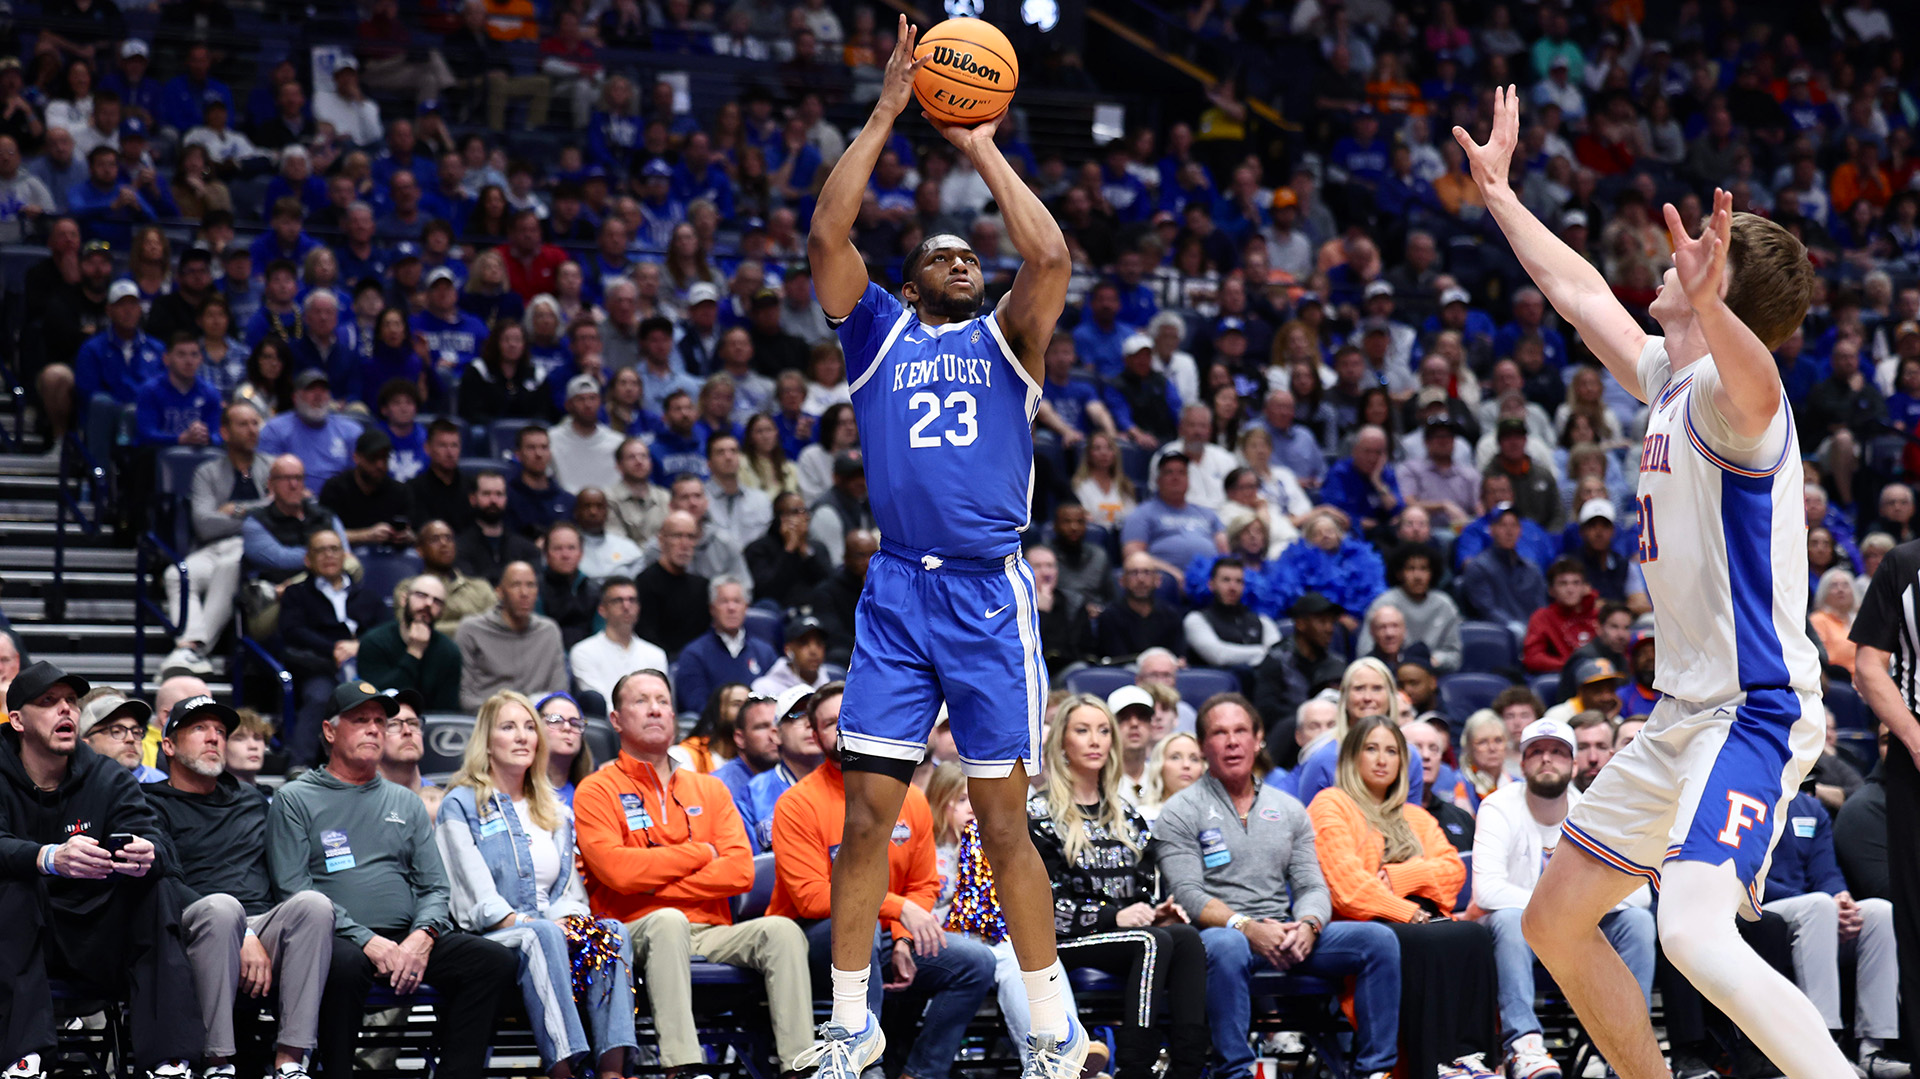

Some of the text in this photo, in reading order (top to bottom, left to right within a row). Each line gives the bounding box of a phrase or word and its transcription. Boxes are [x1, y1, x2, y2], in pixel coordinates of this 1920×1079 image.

[933, 46, 1000, 84] Wilson
[934, 89, 978, 110] EVO
[893, 354, 992, 392] KENTUCKY
[909, 391, 978, 448] 23
[1717, 789, 1768, 849] F
